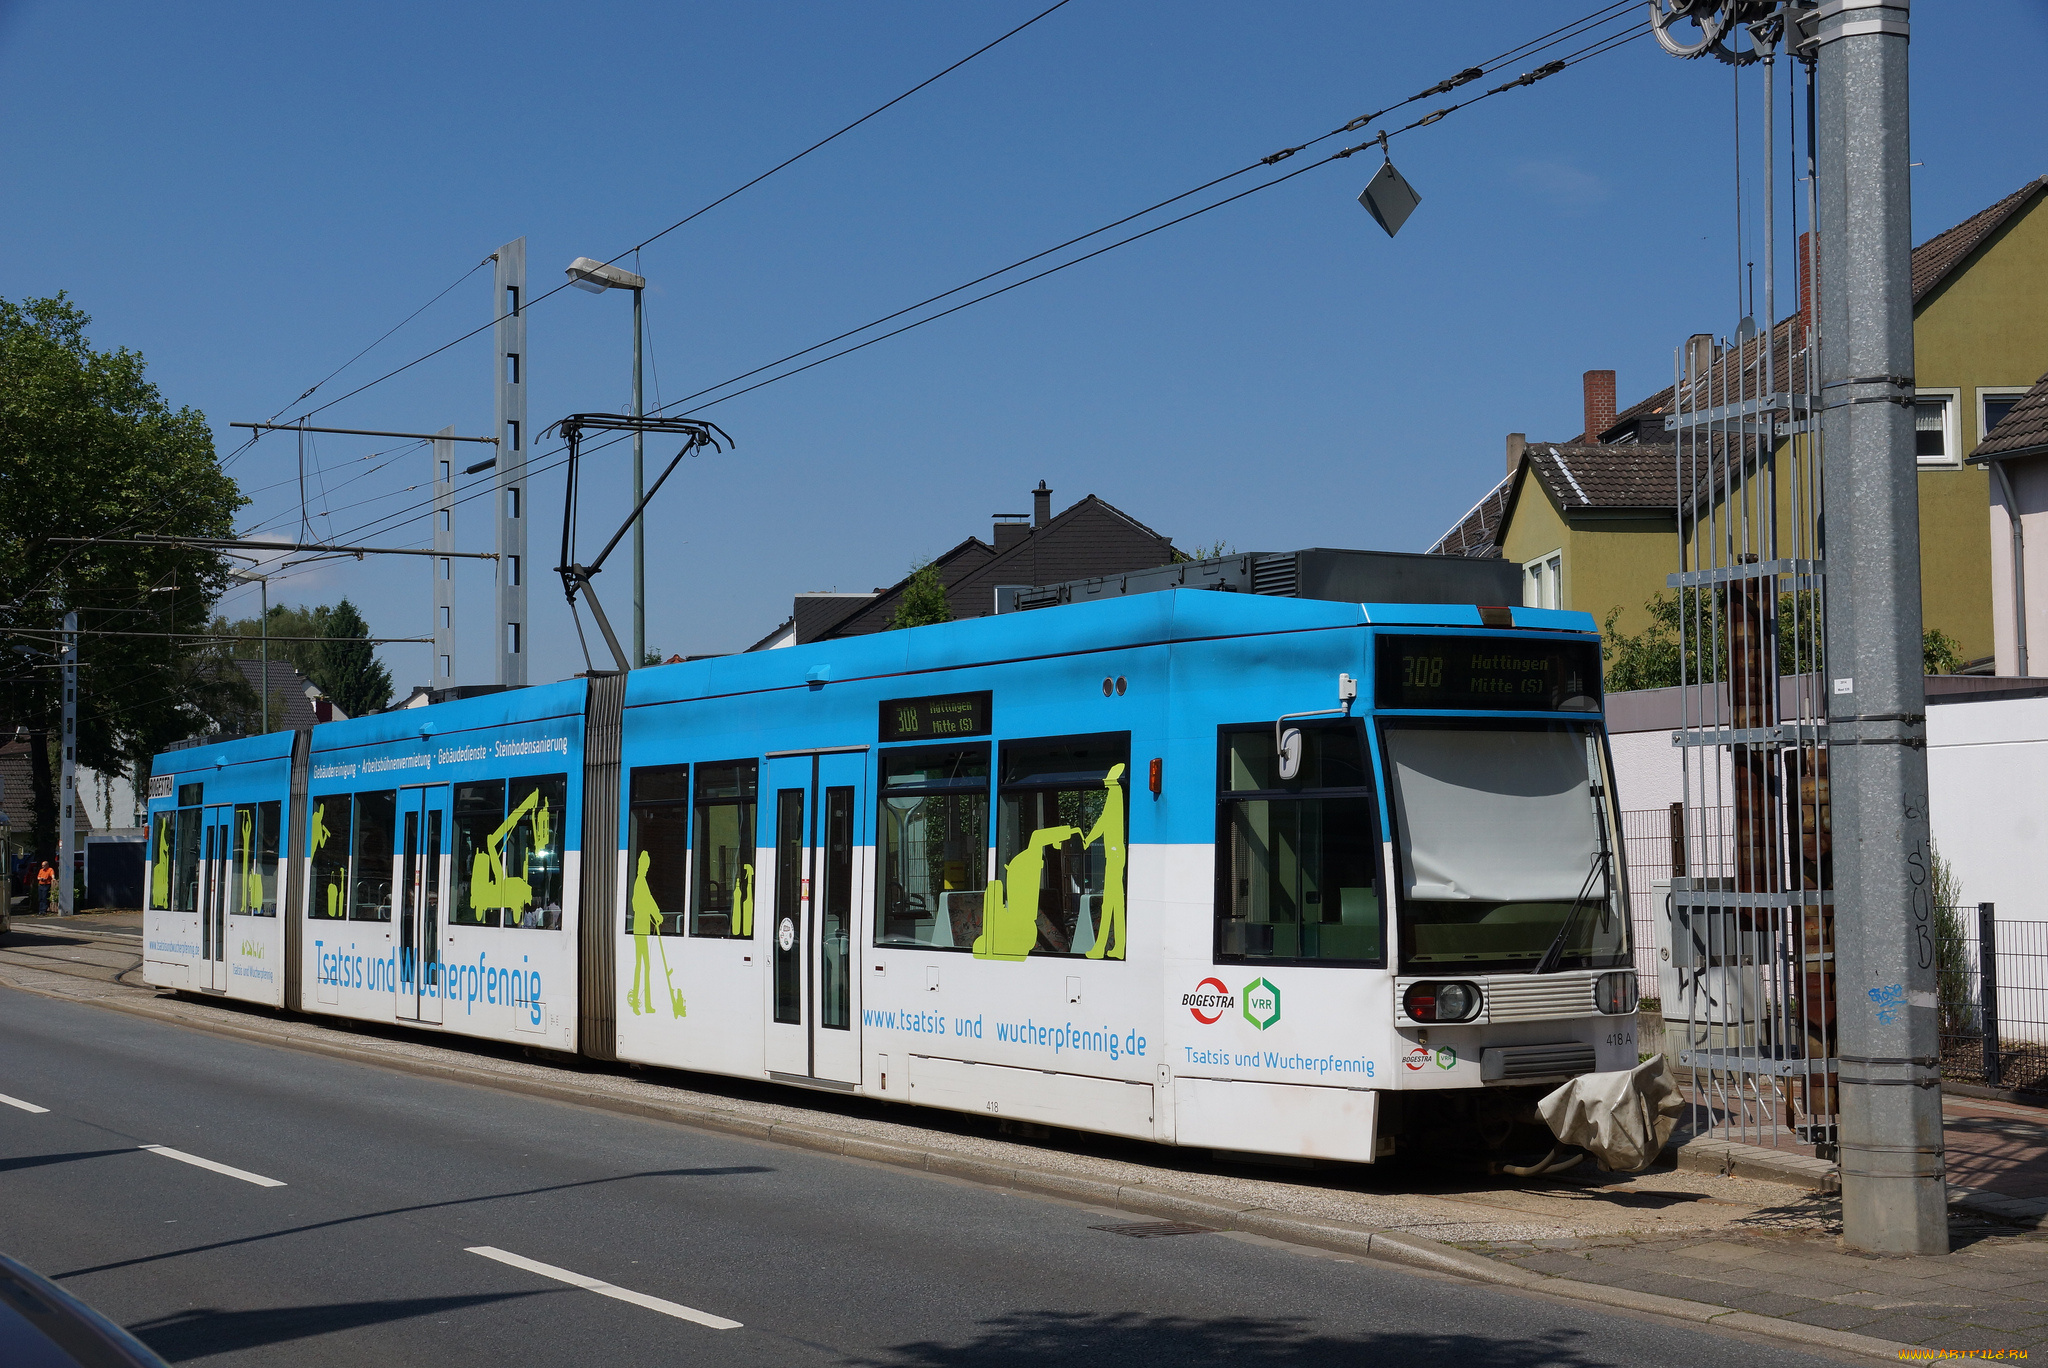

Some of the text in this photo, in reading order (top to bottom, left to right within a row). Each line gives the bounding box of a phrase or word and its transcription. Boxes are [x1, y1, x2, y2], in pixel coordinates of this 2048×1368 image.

[1402, 654, 1549, 688] 308 Hattingen
[1471, 677, 1543, 694] Mitte (S)
[896, 706, 919, 732] 308
[932, 717, 973, 734] Mitte (S)
[437, 744, 487, 765] Gebäudedienste
[494, 735, 568, 755] Steinbodensanierung
[315, 940, 542, 1026] Tsatsis und Wucherpfennig
[1181, 993, 1235, 1009] BOGESTRA
[1251, 998, 1273, 1010] VRR
[862, 1008, 1147, 1061] www.tsatsis und wucherpfennig.de
[1606, 1032, 1632, 1046] 418 A
[1185, 1046, 1375, 1078] Tsatsis und Wucherpfennig
[1402, 1055, 1432, 1063] BOGESTRA
[986, 1100, 999, 1113] 418
